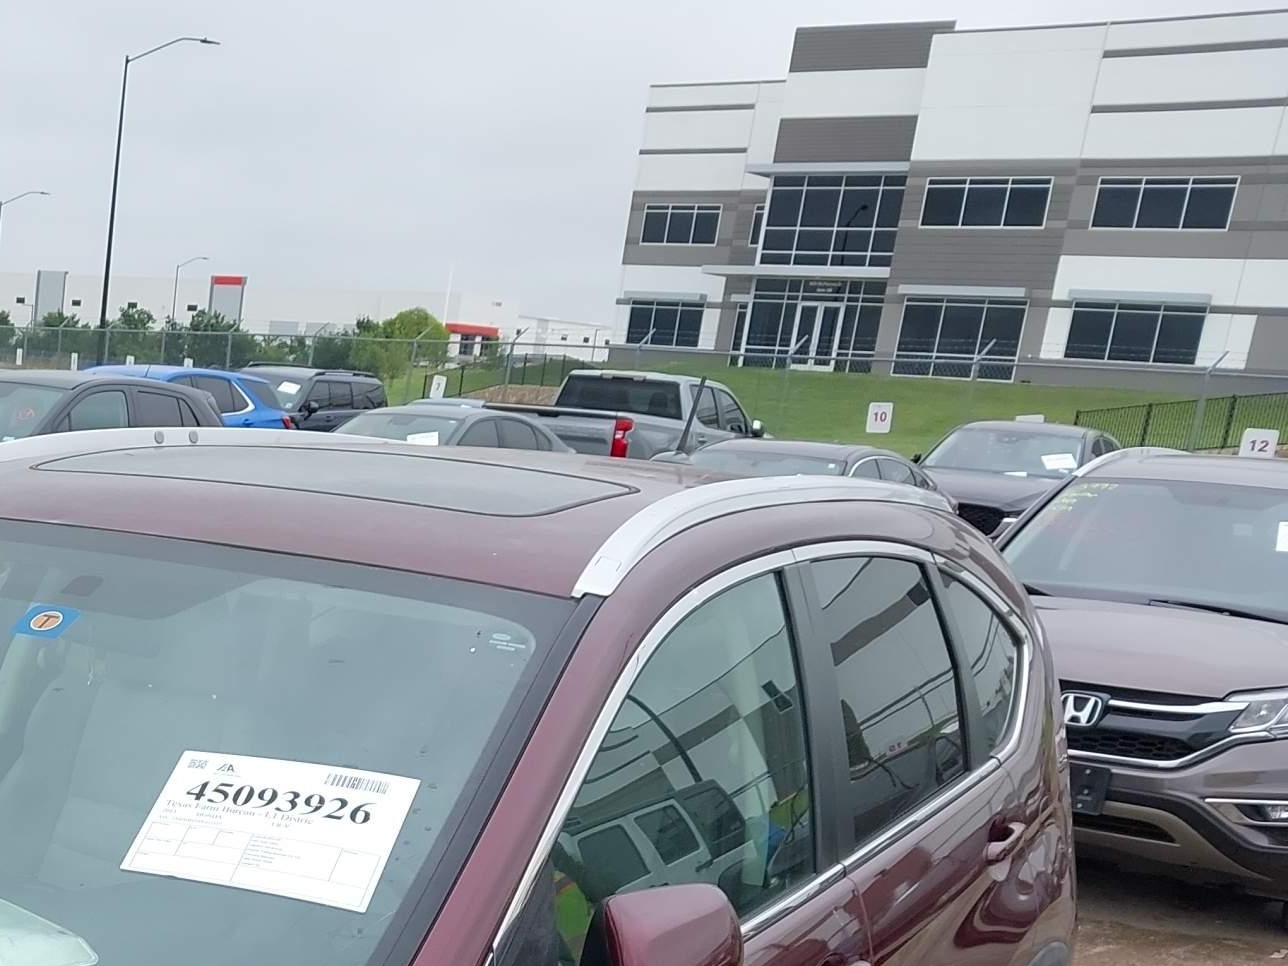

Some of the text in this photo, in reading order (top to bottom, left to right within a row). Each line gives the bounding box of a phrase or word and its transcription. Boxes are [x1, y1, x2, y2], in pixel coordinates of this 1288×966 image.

[873, 411, 888, 423] 10
[1249, 440, 1270, 453] 12
[186, 781, 376, 825] 45093926
